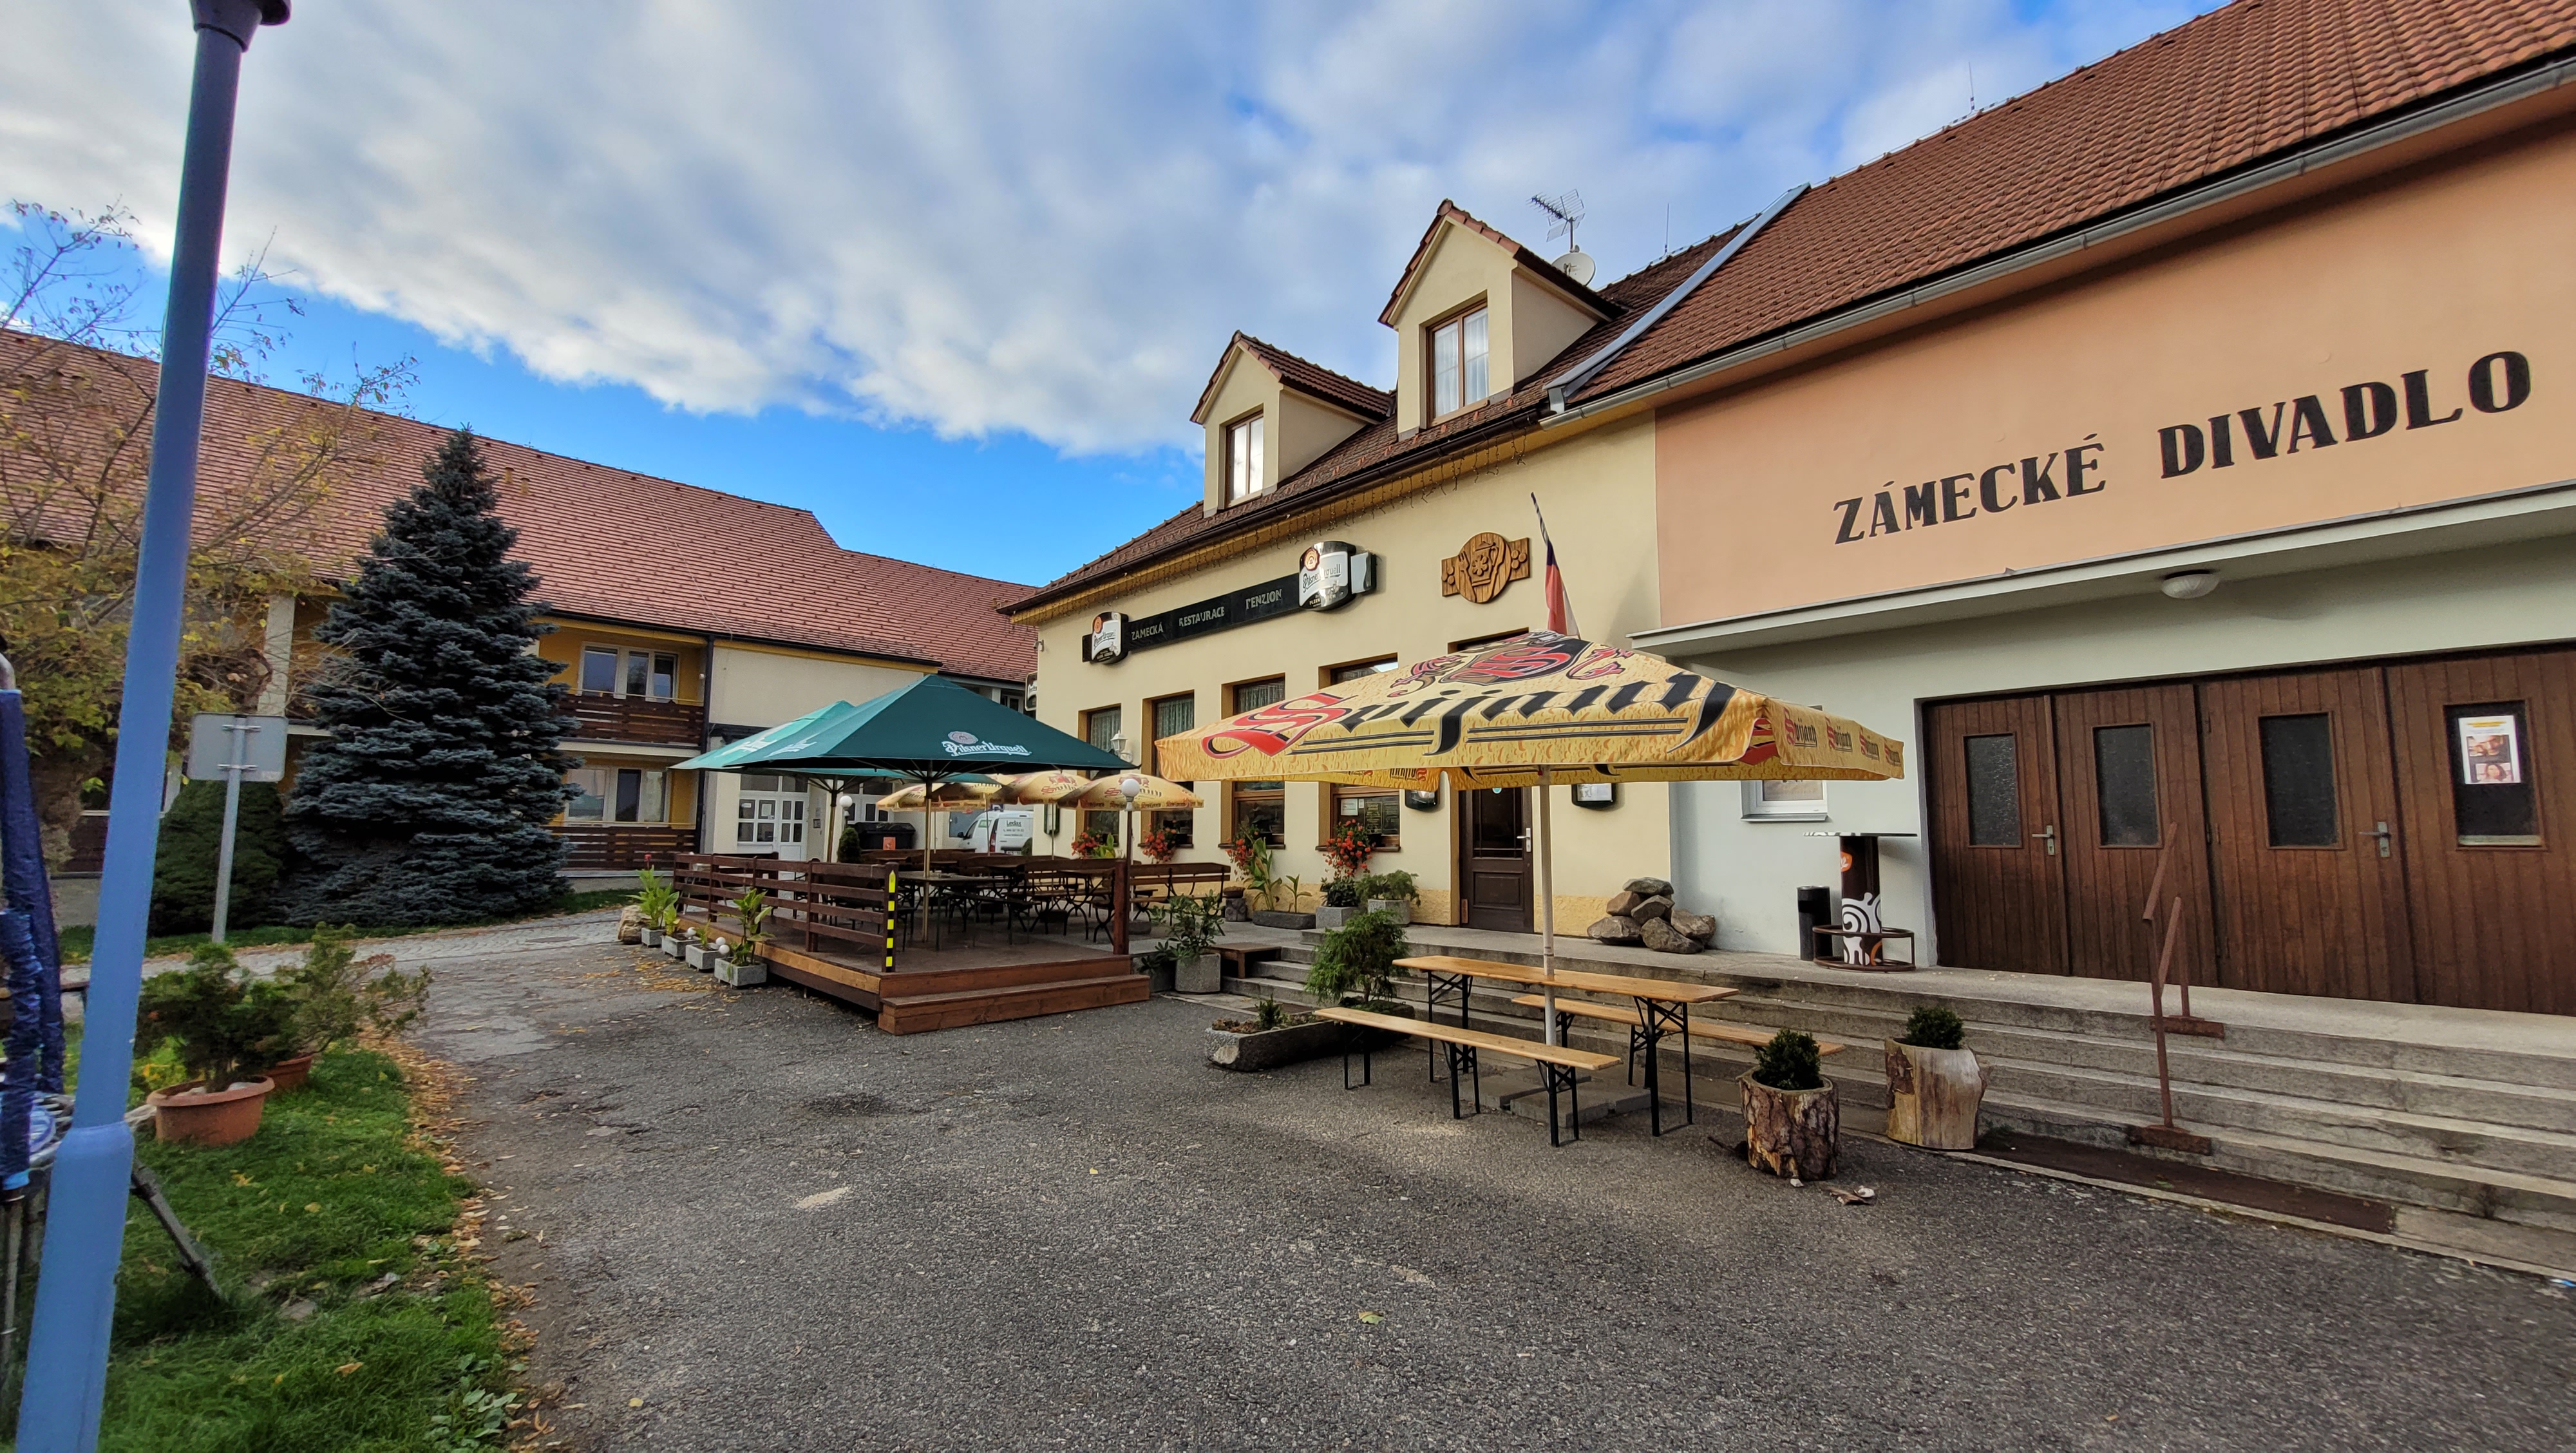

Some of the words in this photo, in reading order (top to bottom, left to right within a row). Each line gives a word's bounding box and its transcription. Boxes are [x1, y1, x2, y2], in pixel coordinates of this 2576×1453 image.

[1833, 433, 2107, 545] ZÁMECKÉ
[2157, 351, 2532, 479] DIVADLO
[1179, 606, 1225, 627] RESTAURACE
[1245, 588, 1282, 610] PENZION
[1200, 672, 1737, 759] Svijany
[1784, 707, 1818, 747] Svijany
[942, 741, 988, 757] Pilsner
[982, 741, 1028, 755] Urquell
